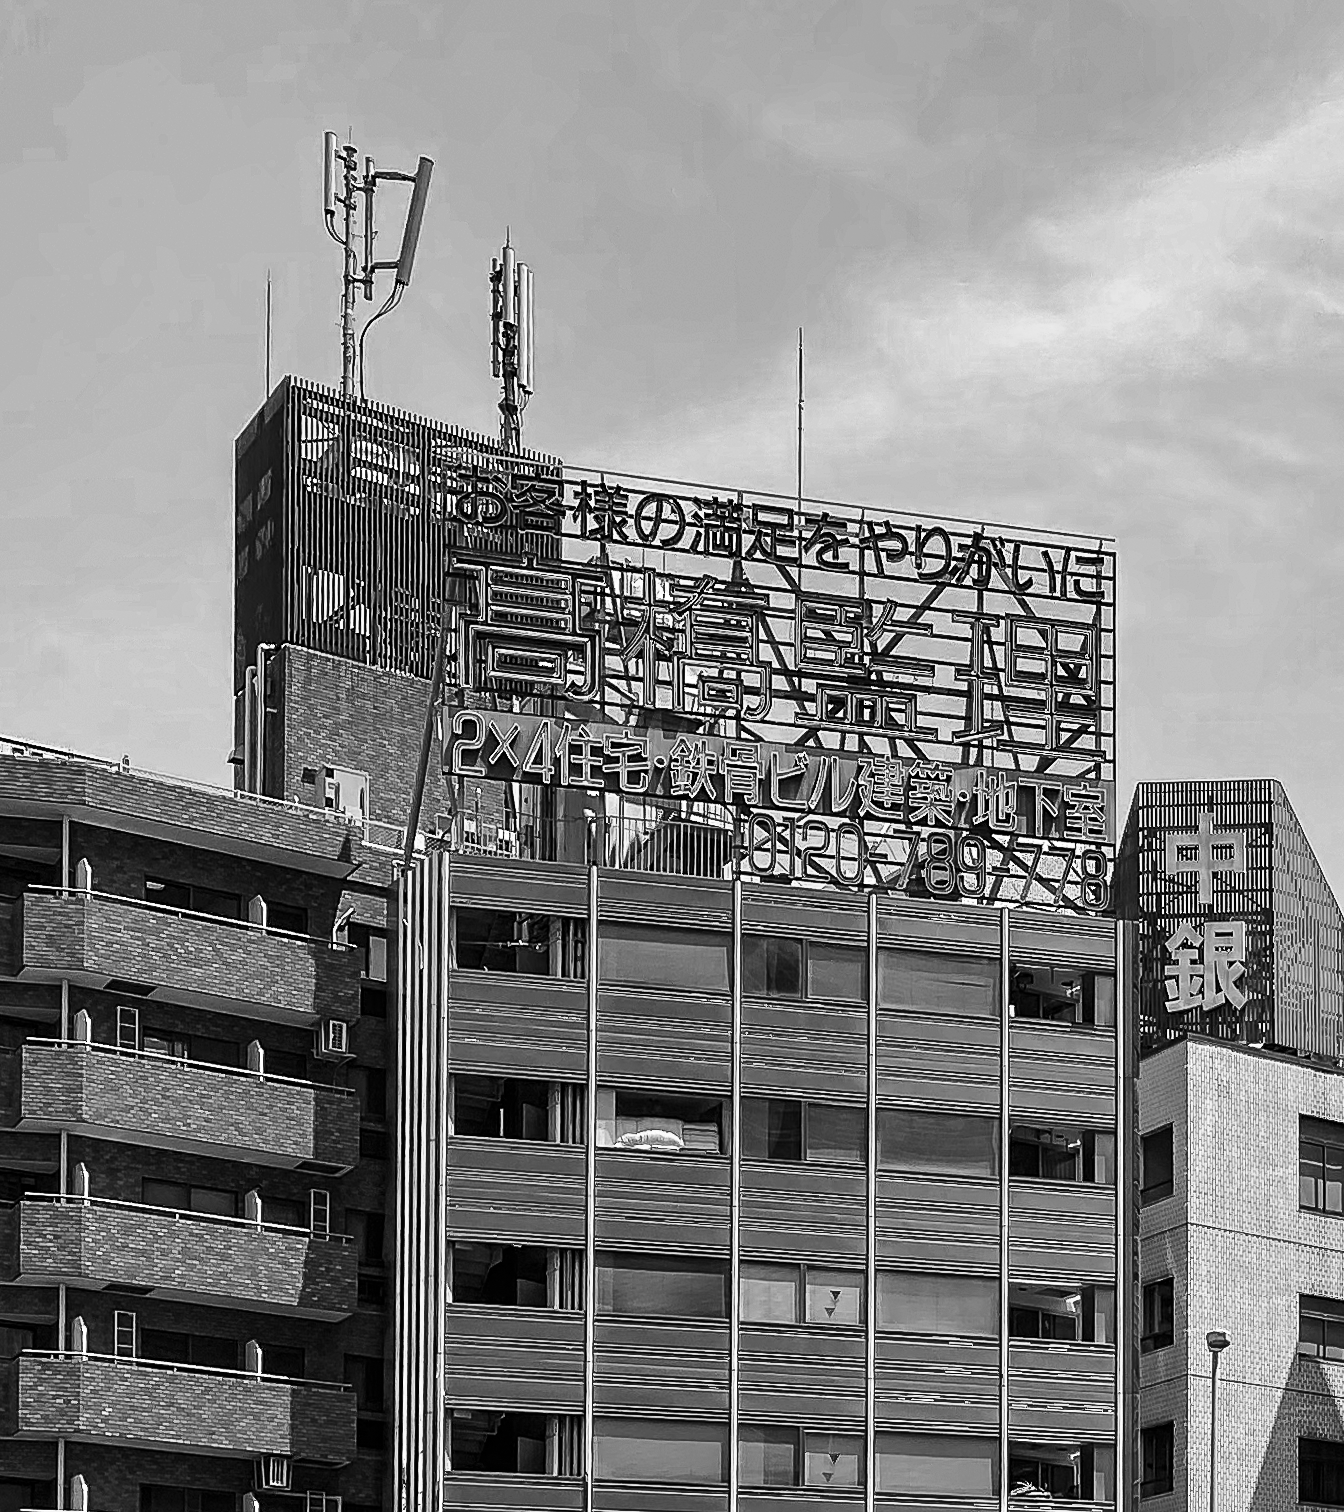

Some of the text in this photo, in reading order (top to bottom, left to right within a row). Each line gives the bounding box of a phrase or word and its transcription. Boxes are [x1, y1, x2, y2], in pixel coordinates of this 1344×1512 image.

[452, 466, 1105, 600] お客様の満足をやりがいに
[748, 812, 1111, 911] 0120-789-778
[1164, 811, 1248, 1013] 中銀
